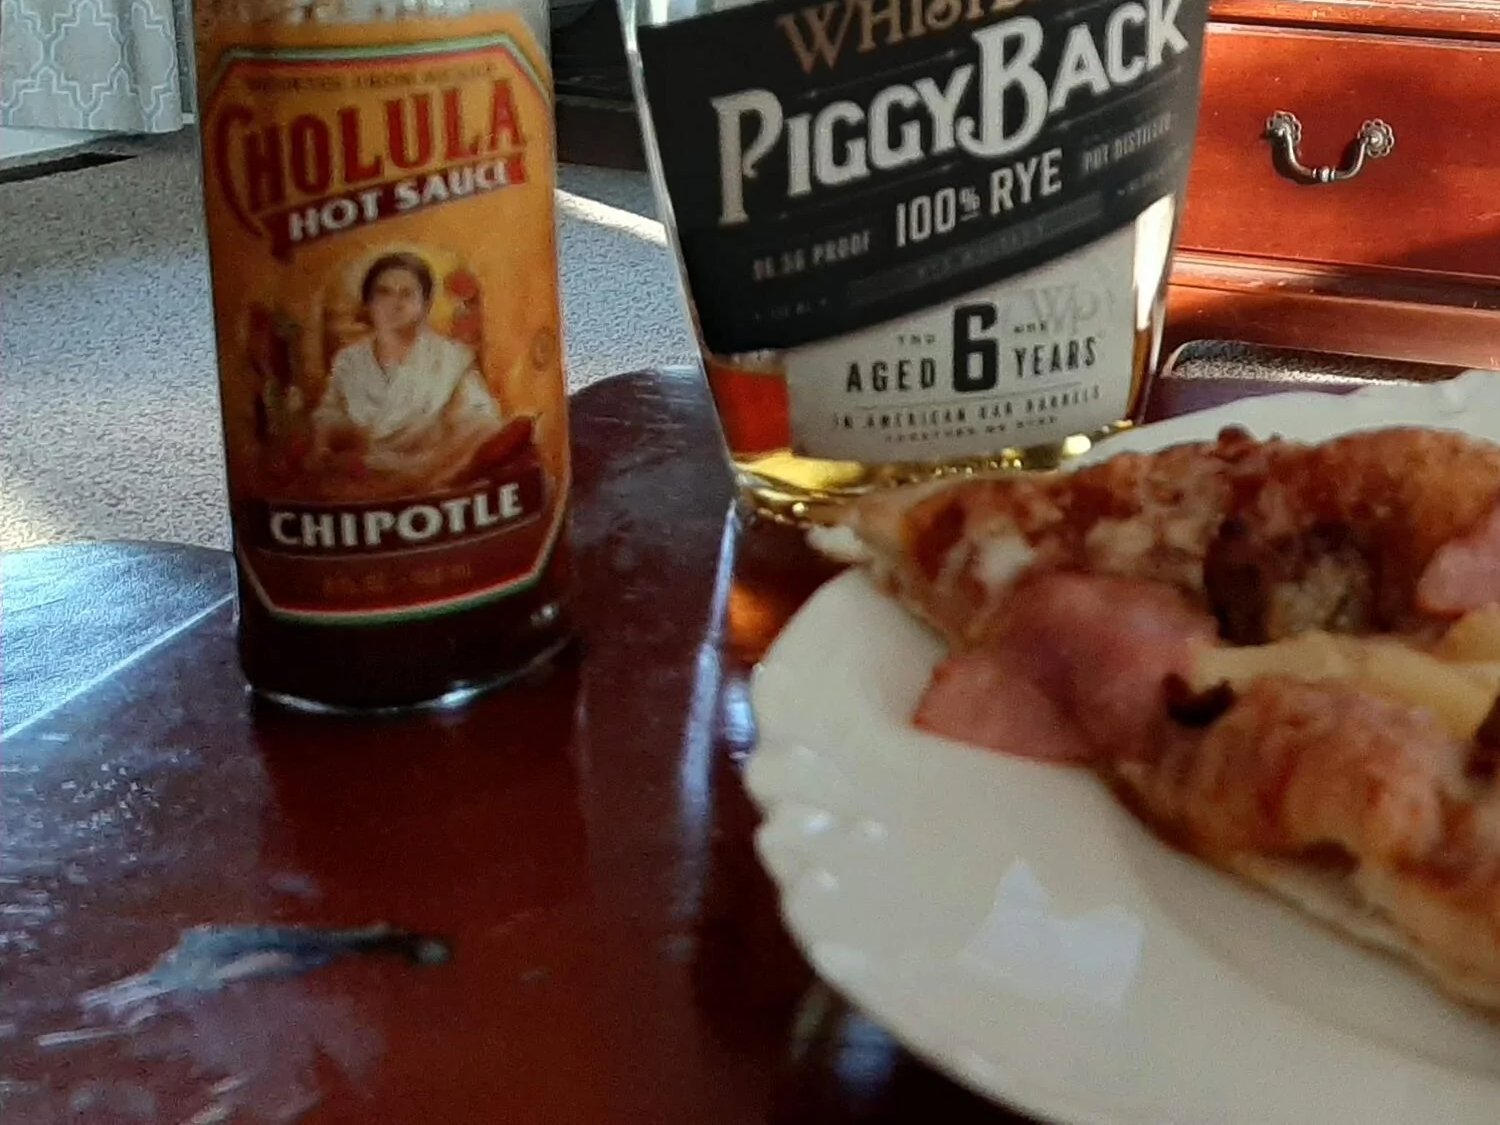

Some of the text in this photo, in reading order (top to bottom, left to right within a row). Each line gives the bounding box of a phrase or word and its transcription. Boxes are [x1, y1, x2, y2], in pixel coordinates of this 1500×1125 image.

[215, 79, 528, 238] CHOLULA
[287, 158, 509, 243] HOT SAUCE
[896, 185, 981, 247] 100%
[990, 147, 1064, 217] RYE
[845, 300, 1098, 394] AGED 6 YEARS
[269, 481, 523, 549] CHIPOTLE
